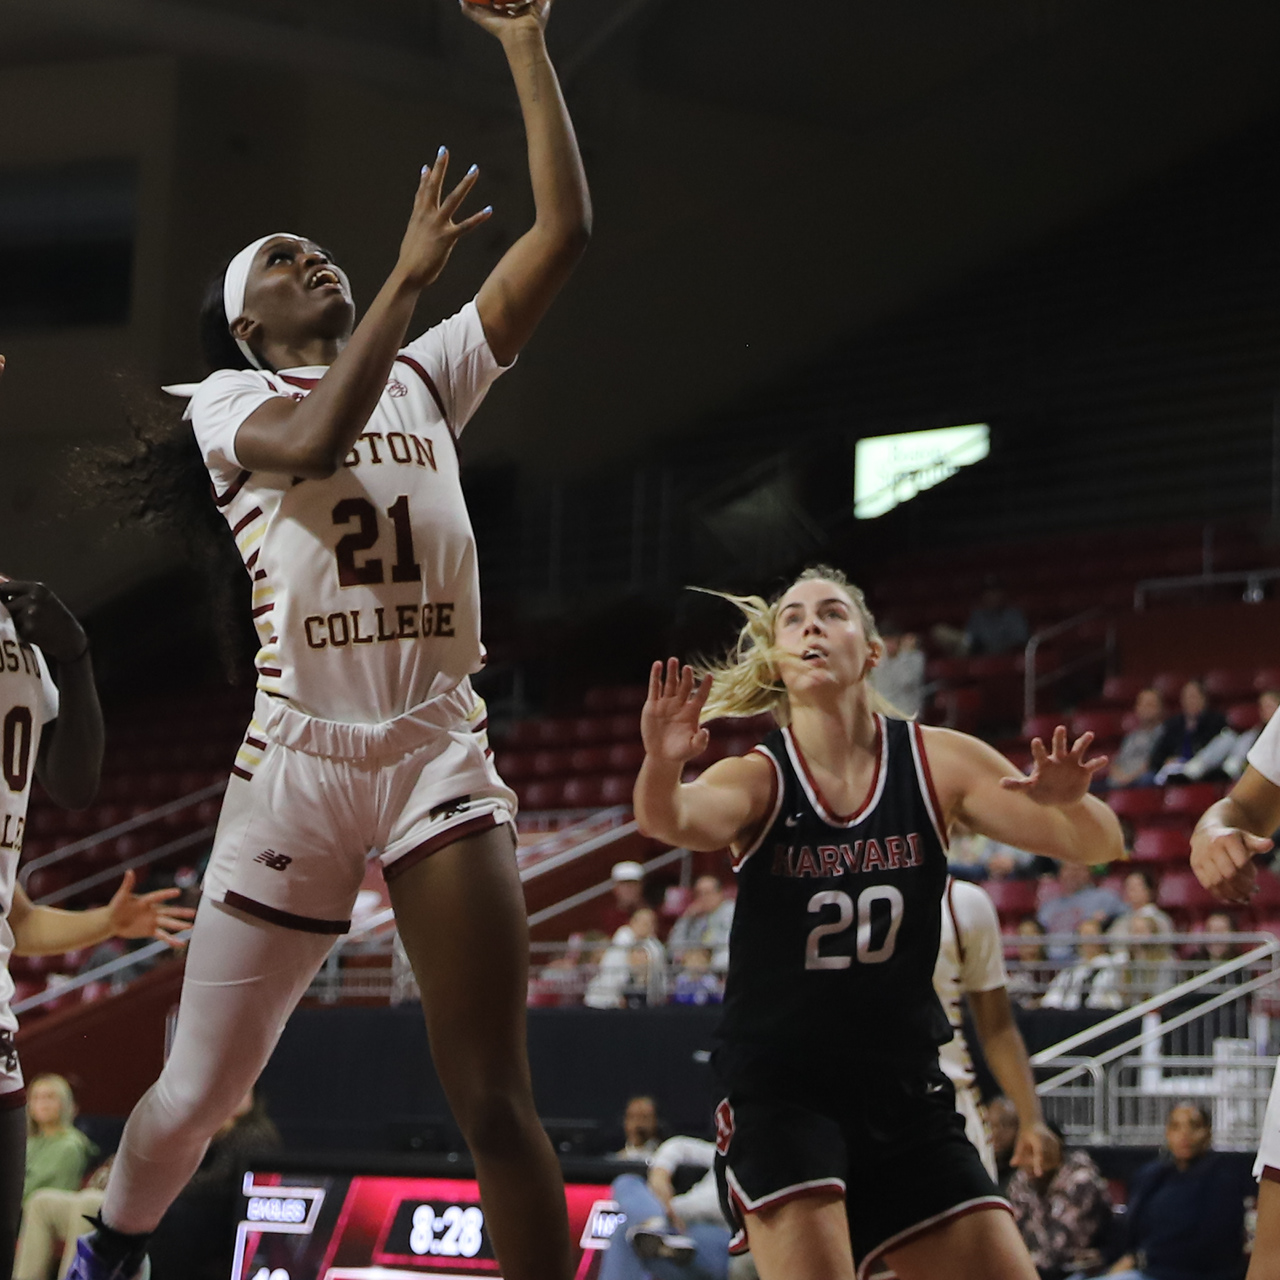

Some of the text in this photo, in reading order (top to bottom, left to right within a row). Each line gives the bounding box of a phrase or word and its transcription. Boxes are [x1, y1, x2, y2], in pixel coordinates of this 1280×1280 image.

[332, 495, 422, 588] 21
[304, 602, 455, 649] COLLEGE
[2, 705, 32, 792] 0
[804, 884, 905, 971] 20
